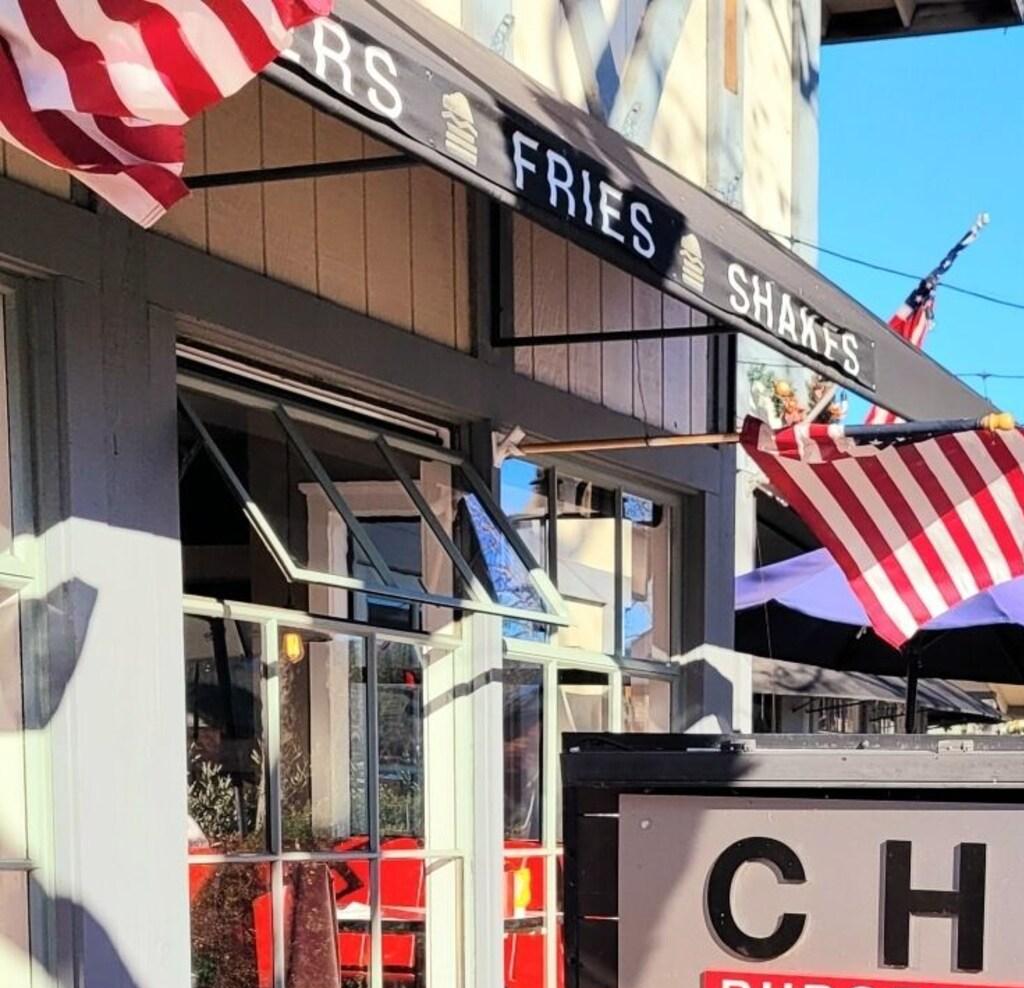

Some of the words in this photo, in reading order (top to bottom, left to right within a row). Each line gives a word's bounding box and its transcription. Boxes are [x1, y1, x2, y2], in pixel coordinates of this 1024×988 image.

[280, 17, 402, 118] RS
[512, 130, 656, 258] FRIES
[728, 263, 860, 376] SHAKES
